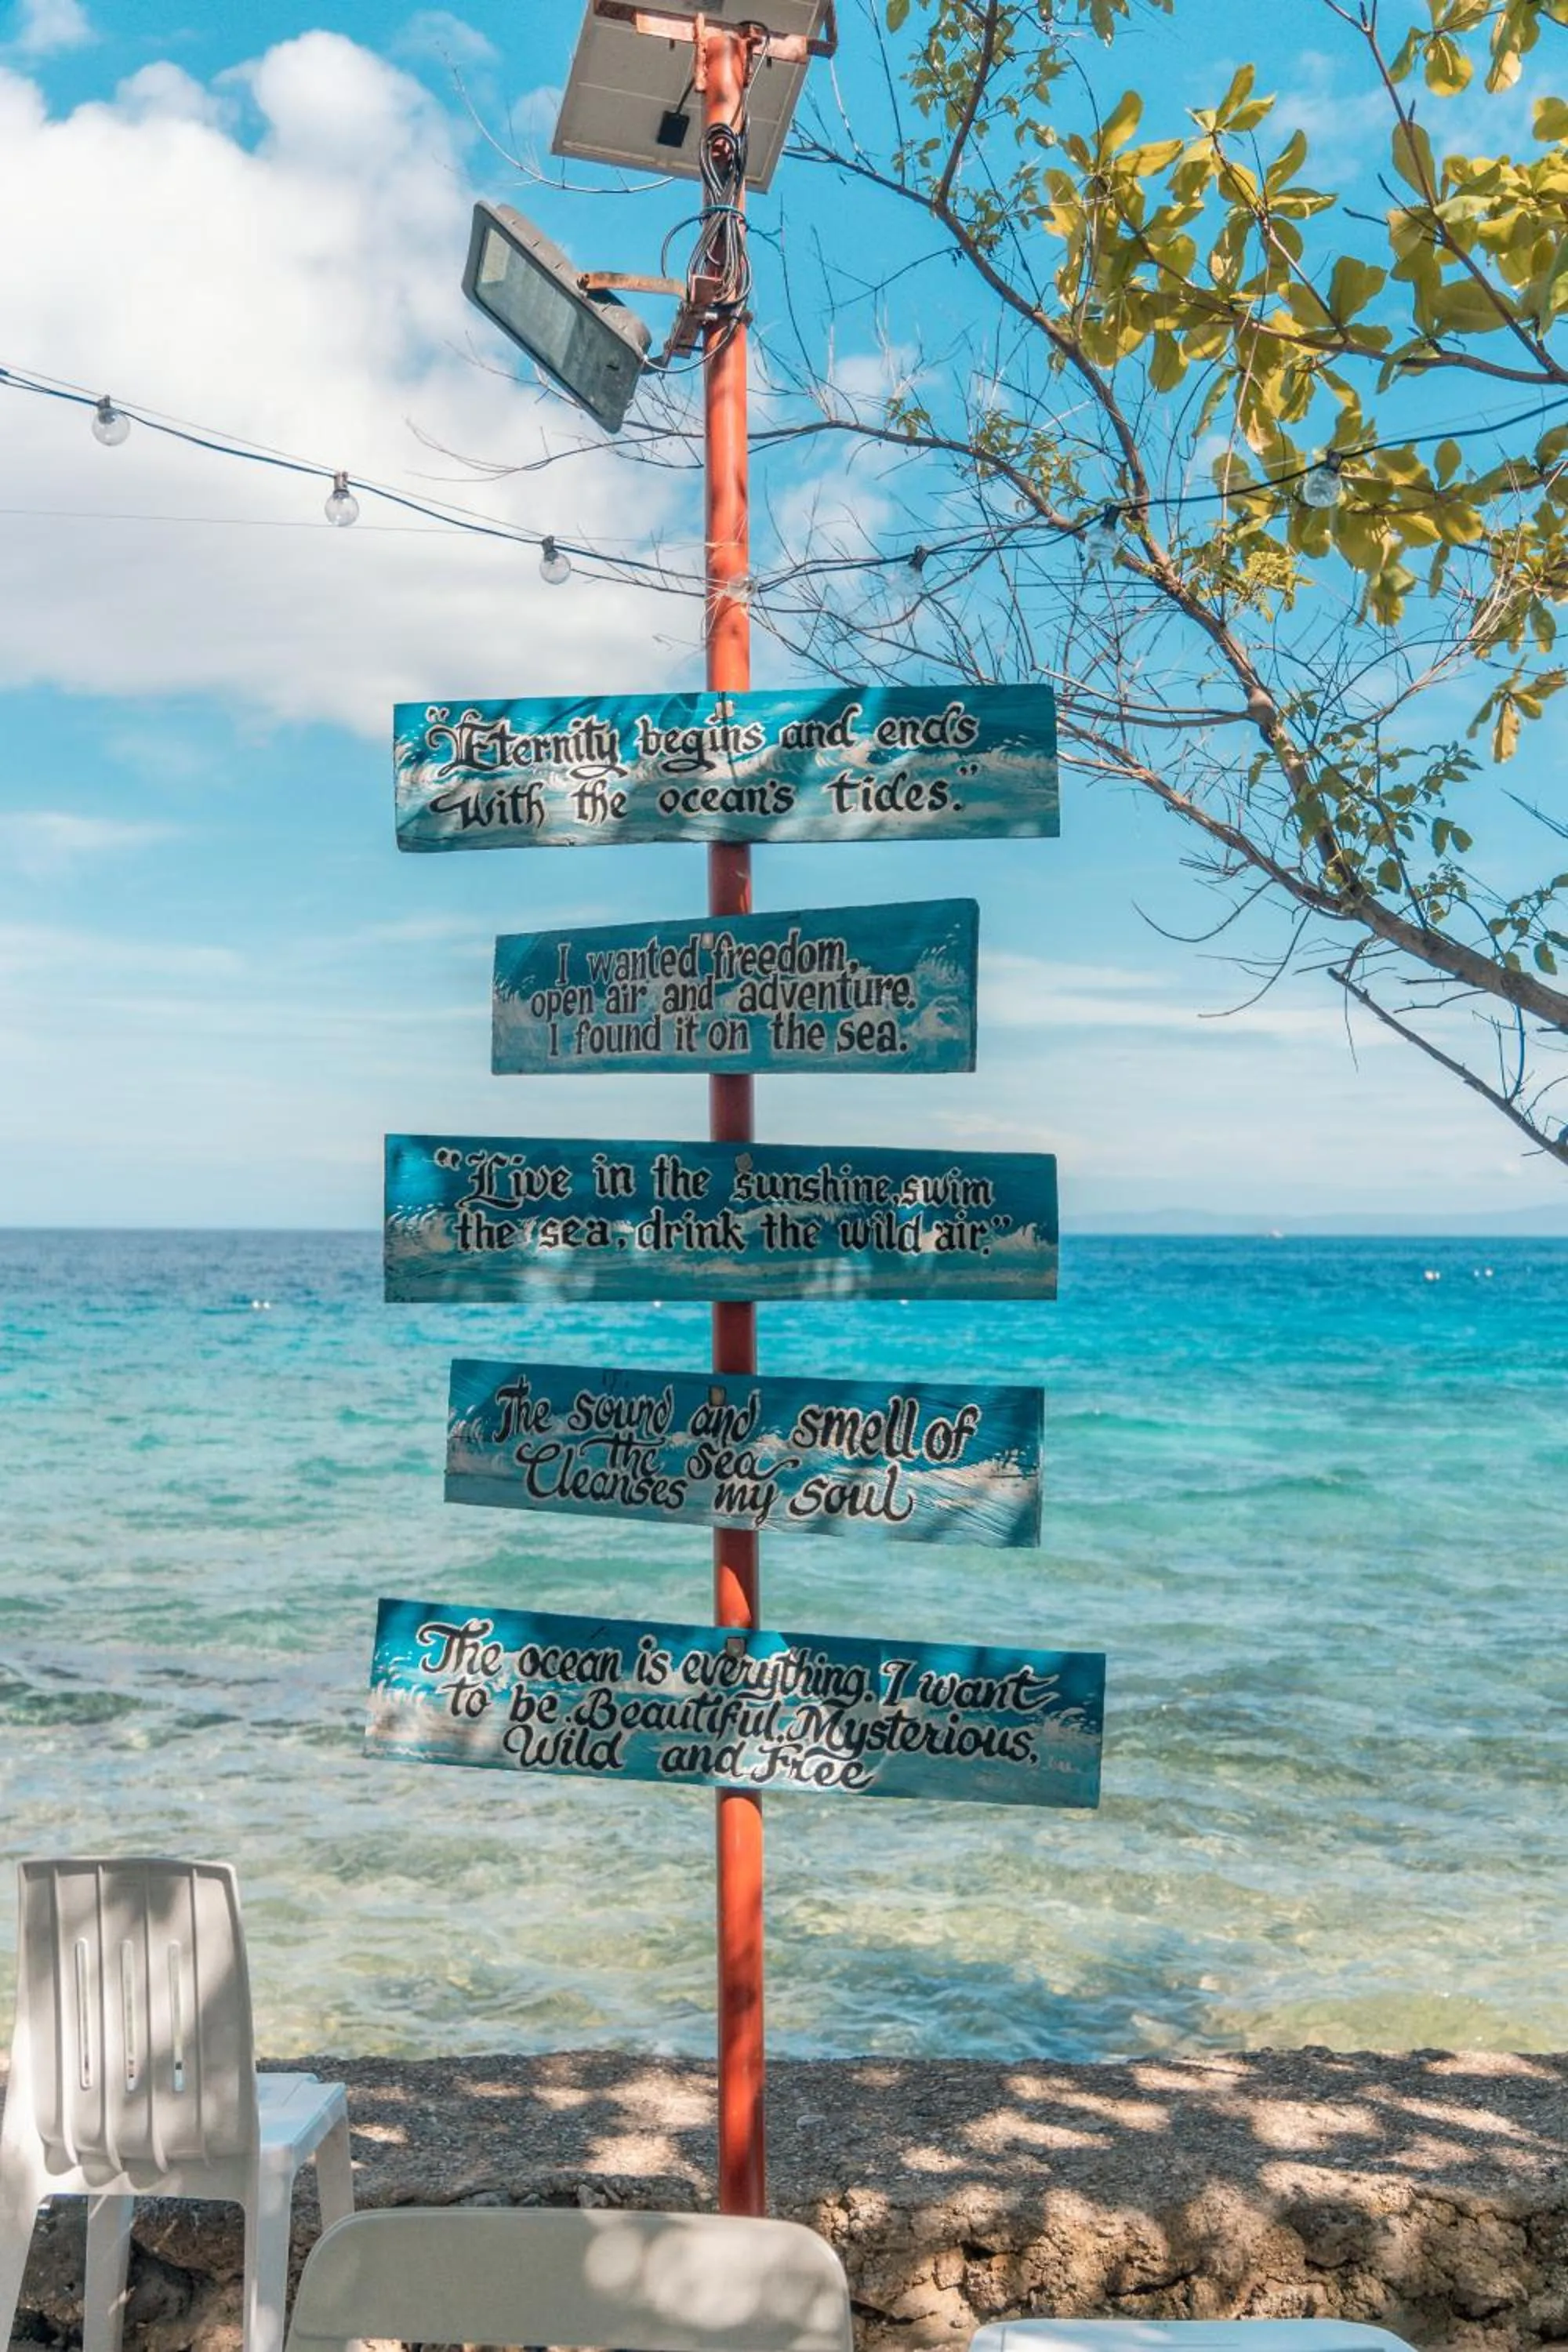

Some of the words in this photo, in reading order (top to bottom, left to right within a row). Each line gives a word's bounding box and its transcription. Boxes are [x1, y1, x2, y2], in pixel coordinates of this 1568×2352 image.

[637, 714, 766, 773] begins
[782, 704, 861, 750] and
[877, 704, 978, 746] ends
[572, 779, 630, 824] the
[660, 779, 794, 817] ocean's
[556, 945, 571, 985] I
[588, 937, 699, 982] wanted
[530, 985, 593, 1022] open
[605, 983, 647, 1014] air
[662, 974, 715, 1014] and
[550, 1022, 559, 1056] I
[575, 1014, 661, 1054] found
[676, 1018, 699, 1052] it
[708, 1019, 749, 1051] on
[772, 1011, 825, 1050] the
[837, 1020, 909, 1052] sea.
[594, 1154, 634, 1197] in
[655, 1156, 712, 1198] the
[900, 1168, 994, 1205] swim
[455, 1208, 514, 1250] the
[540, 1218, 626, 1248] sea,
[638, 1209, 746, 1250] drink
[760, 1212, 822, 1250] the
[839, 1210, 923, 1253] wild
[494, 1376, 552, 1442] The
[568, 1386, 673, 1436] sound
[690, 1391, 760, 1448] and
[793, 1397, 916, 1458] smell
[924, 1405, 980, 1461] of
[579, 1432, 666, 1479] the
[516, 1441, 688, 1509] Cleanses
[714, 1482, 778, 1525] my
[789, 1465, 914, 1522] soul
[417, 1620, 502, 1675] The
[518, 1645, 622, 1682] ocean
[637, 1637, 670, 1686] is
[883, 1660, 914, 1708] I
[920, 1668, 1060, 1711] want
[441, 1676, 488, 1717] to
[503, 1723, 624, 1771] Wild
[661, 1742, 748, 1780] and
[750, 1743, 875, 1790] Free
